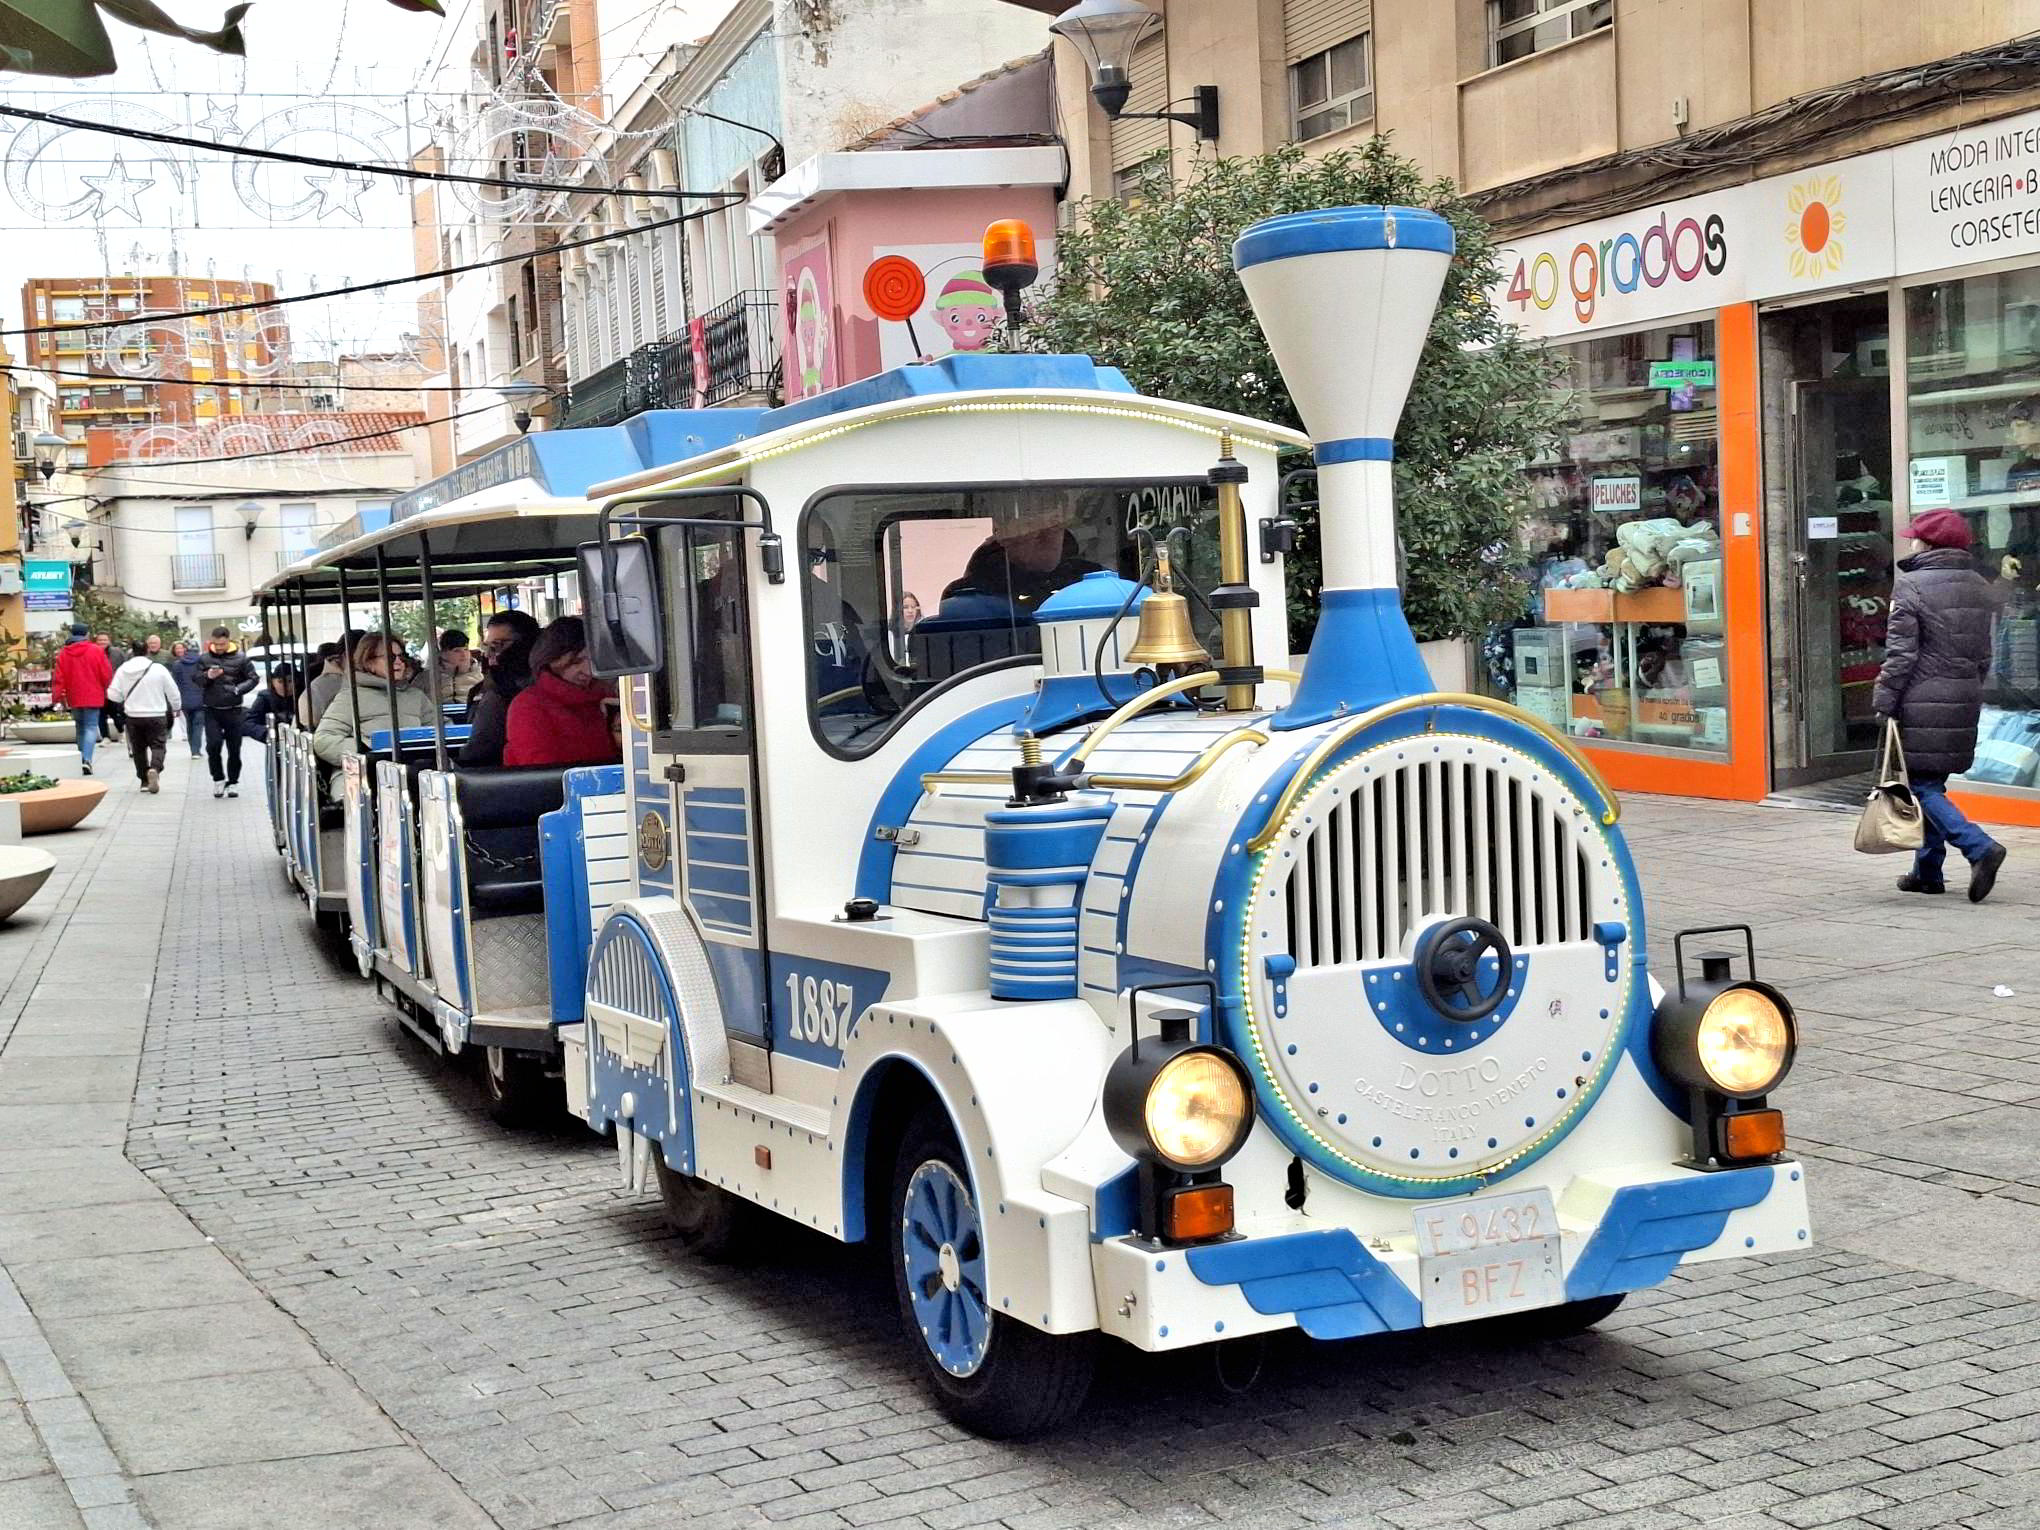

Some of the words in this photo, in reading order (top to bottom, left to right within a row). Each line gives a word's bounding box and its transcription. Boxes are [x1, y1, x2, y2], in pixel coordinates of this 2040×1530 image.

[1930, 140, 1988, 176] MODA
[1930, 173, 2013, 213] LENCERIA
[1507, 252, 1559, 312] 40
[1569, 211, 1727, 324] grados
[1595, 483, 1637, 504] PELUCHES
[786, 973, 853, 1051] 1887
[1353, 1077, 1483, 1123] CASTELFRANCO
[1485, 1056, 1549, 1110] VENETO
[1394, 1056, 1501, 1097] DOTTO
[1432, 1123, 1480, 1143] ITALY
[1460, 1204, 1545, 1250] 9432
[1462, 1258, 1526, 1305] BFZ
